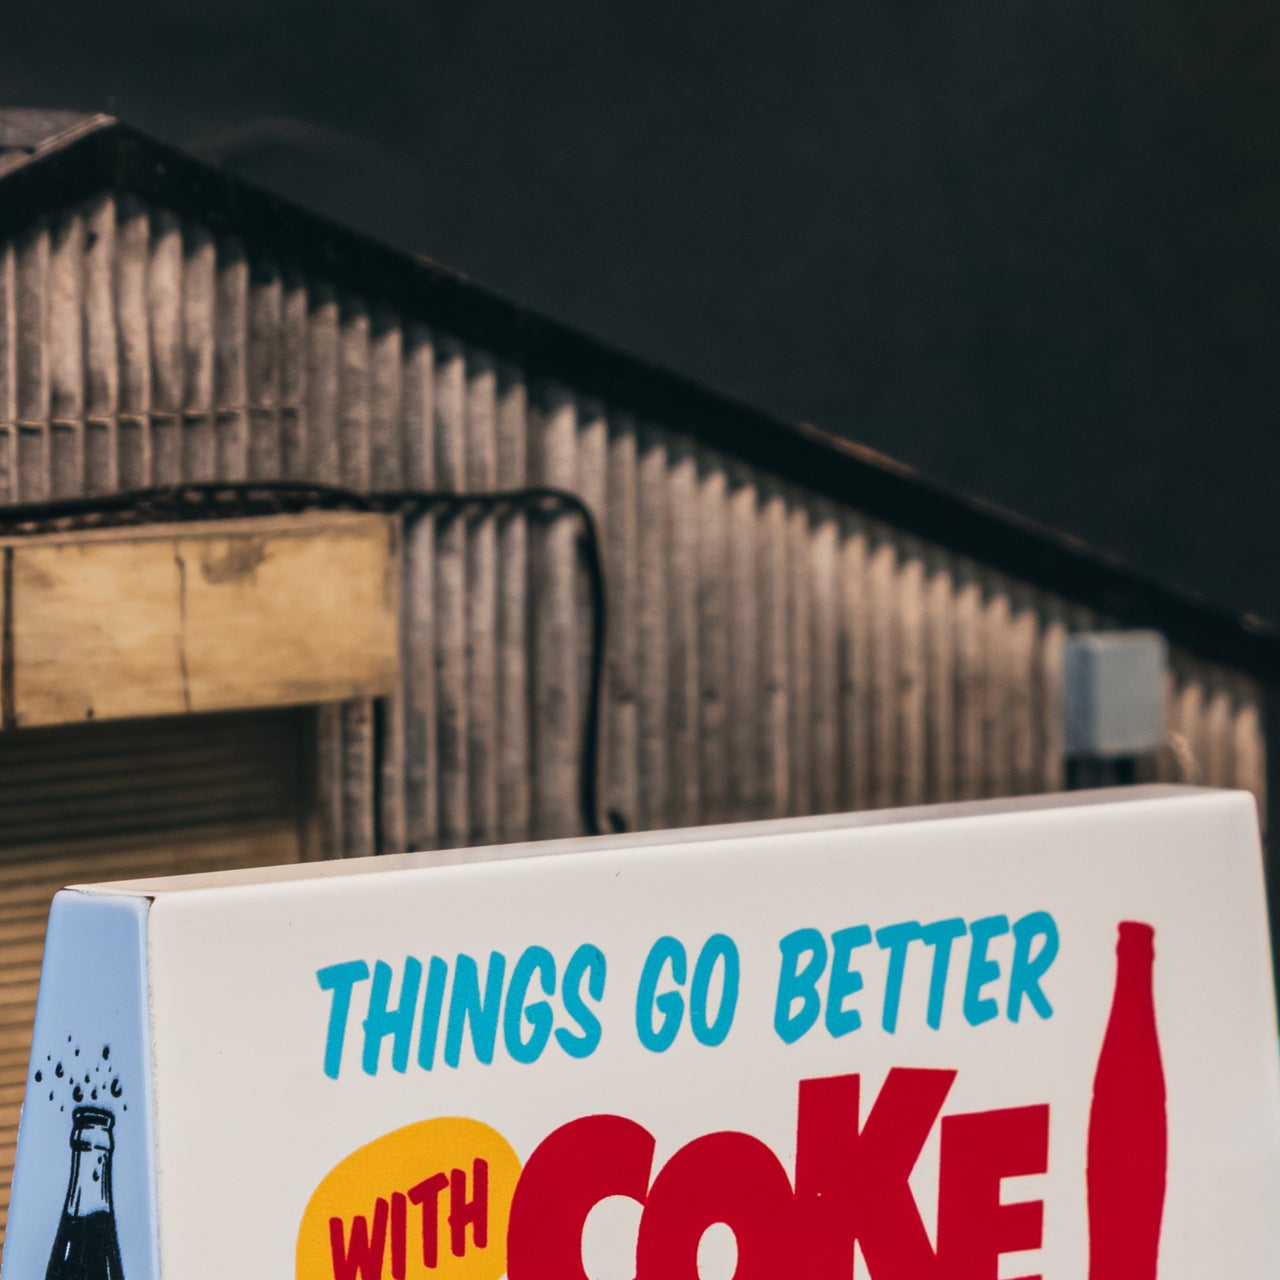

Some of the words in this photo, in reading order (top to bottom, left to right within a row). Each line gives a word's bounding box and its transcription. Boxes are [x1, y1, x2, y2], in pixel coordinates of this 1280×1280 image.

[316, 943, 607, 1080] THINGS
[635, 933, 740, 1053] GO
[773, 910, 1060, 1045] BETTER
